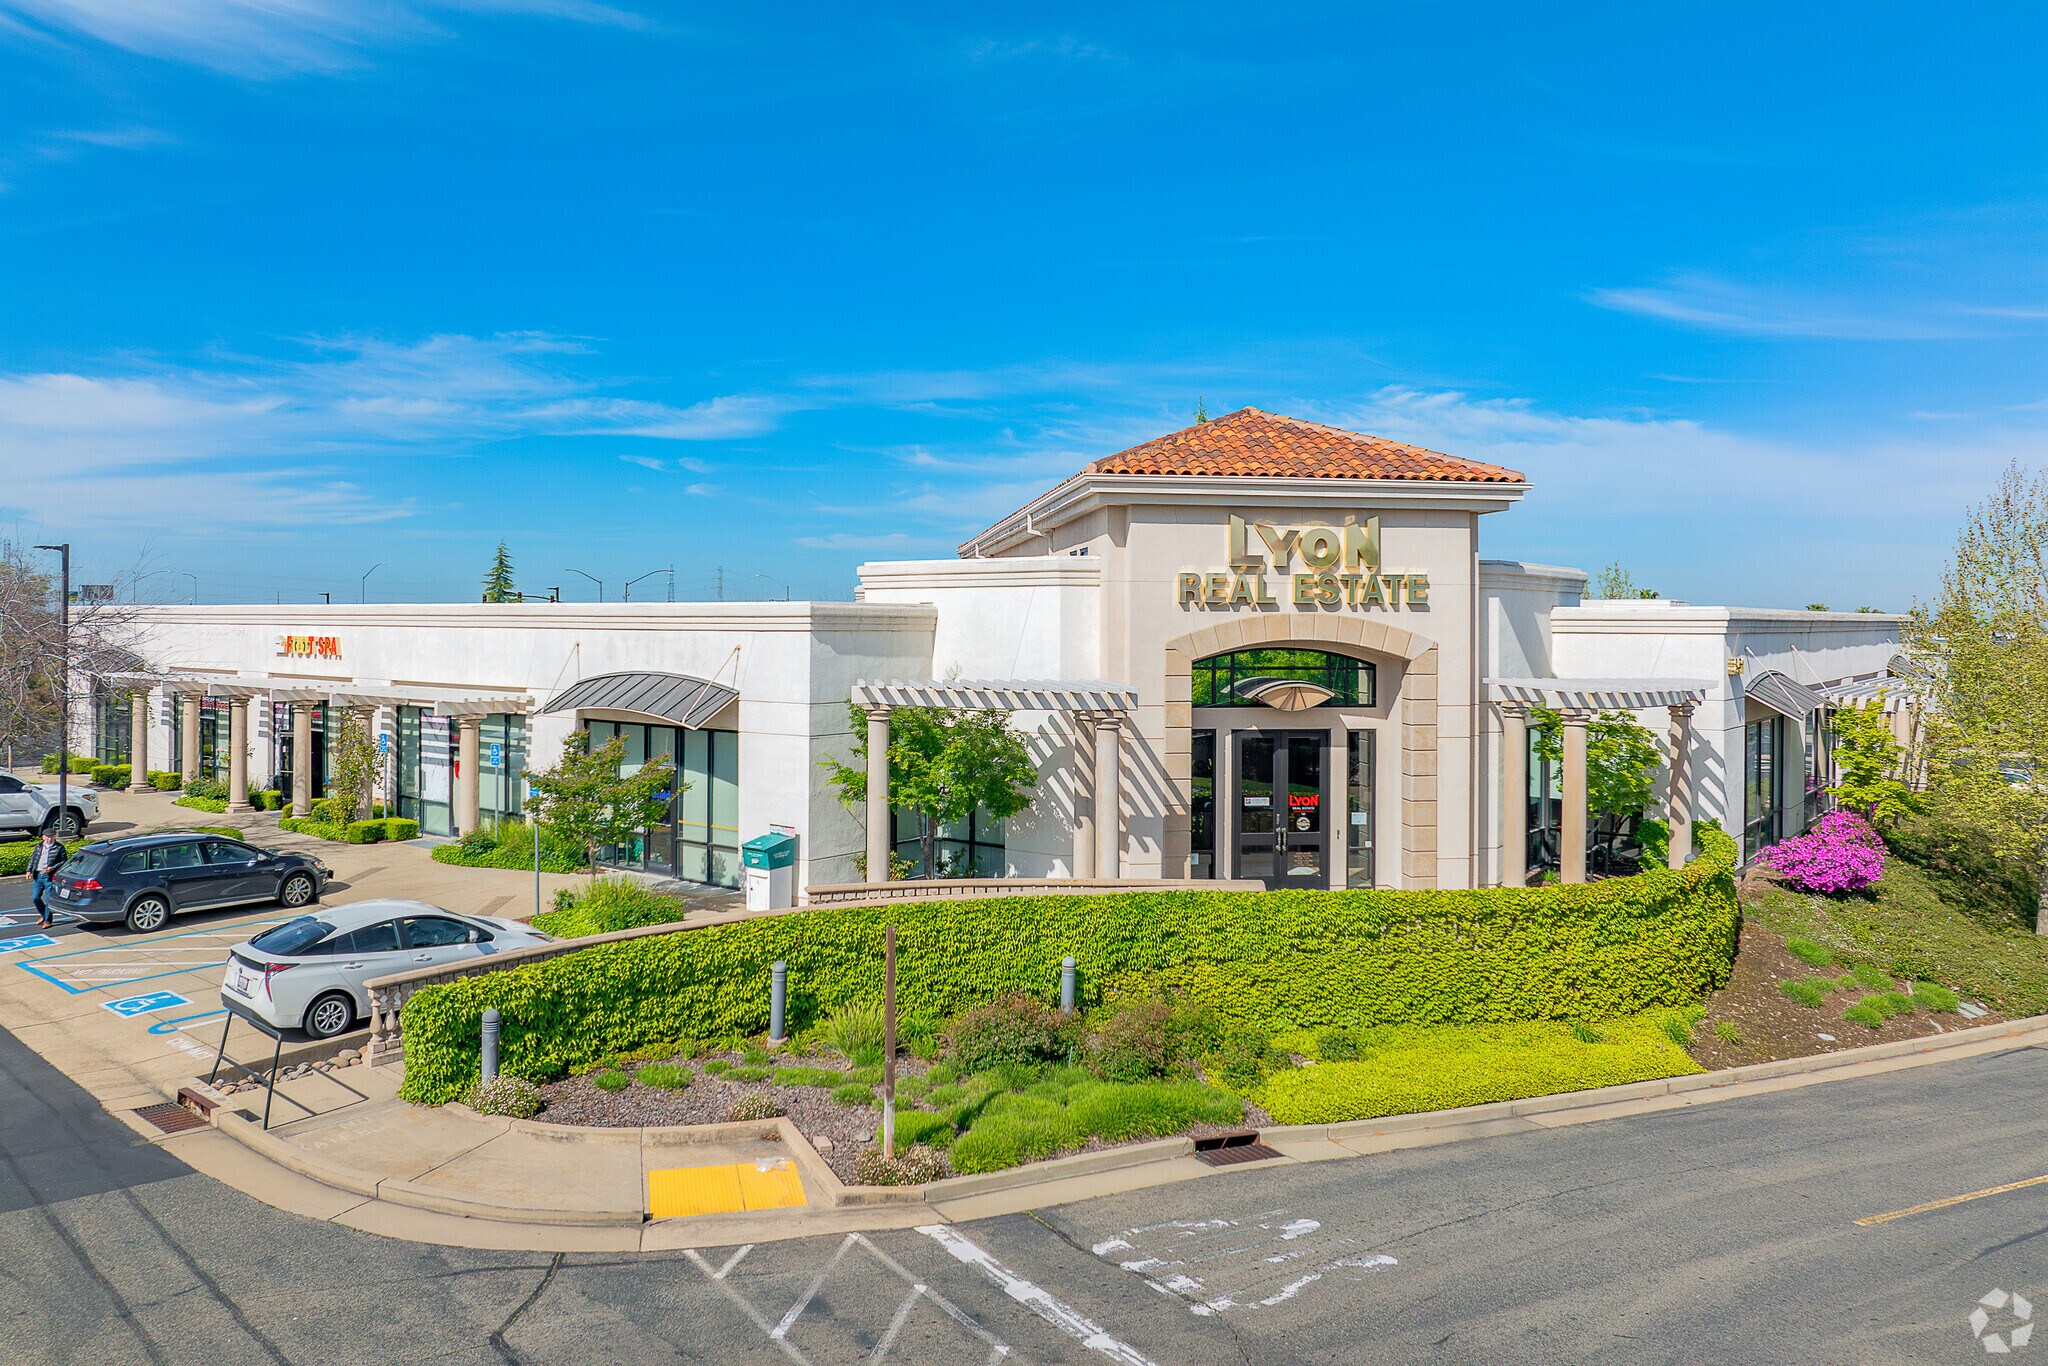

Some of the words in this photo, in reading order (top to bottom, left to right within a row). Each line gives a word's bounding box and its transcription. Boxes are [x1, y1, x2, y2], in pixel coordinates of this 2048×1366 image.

[1229, 513, 1380, 567] LYON
[1178, 572, 1277, 604] REAL
[1293, 573, 1428, 604] ESTATE
[286, 635, 315, 655] FOOT
[318, 636, 337, 655] SPA
[1289, 795, 1319, 806] LYON
